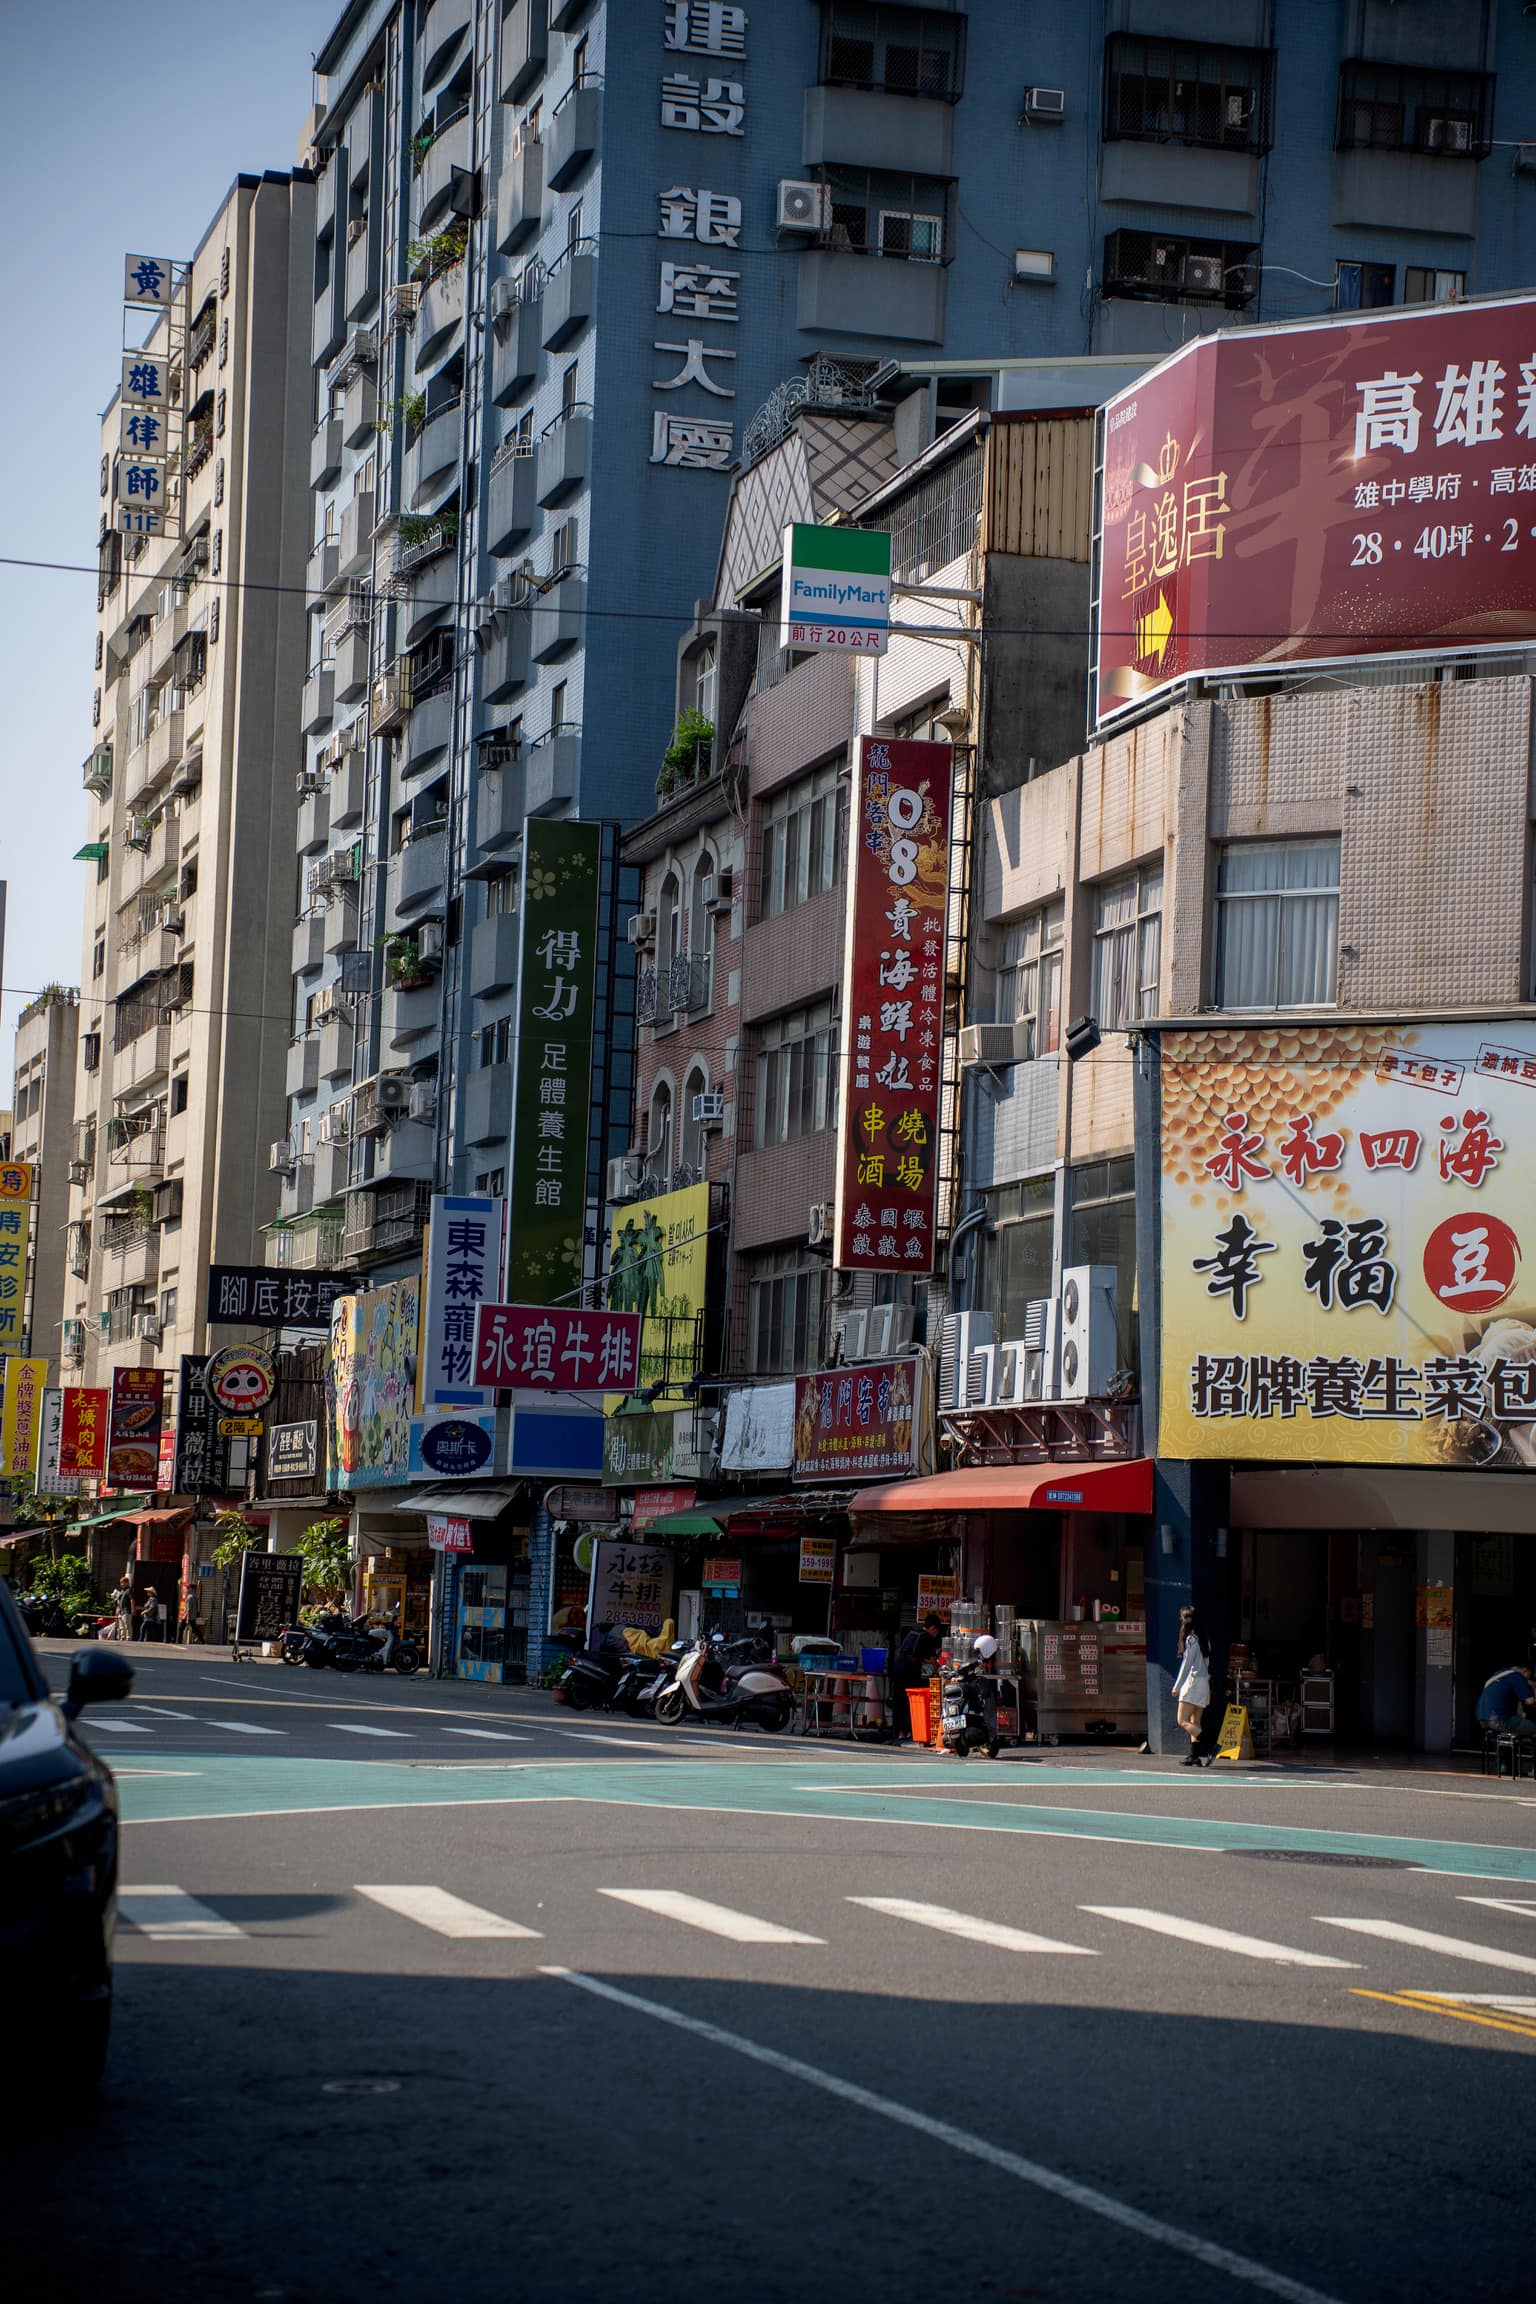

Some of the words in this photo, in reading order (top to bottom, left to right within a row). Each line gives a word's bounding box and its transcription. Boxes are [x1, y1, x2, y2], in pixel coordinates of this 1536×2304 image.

[123, 513, 161, 532] 11F
[1121, 472, 1230, 600] 皇逸居
[794, 580, 886, 605] FamilyMart
[792, 626, 880, 648] 前行20公尺
[532, 928, 582, 1022] 得力
[917, 917, 942, 1091] 批發活體冷凍食品
[1382, 1055, 1457, 1087] 手工包子
[534, 1042, 568, 1207] 足體養生館
[863, 1102, 928, 1145] 串燒
[1205, 1109, 1502, 1190] 永和四海
[856, 1153, 925, 1192] 酒場
[853, 1202, 928, 1229] 泰國蝦
[1193, 1213, 1508, 1320] 幸福豆
[218, 1276, 346, 1319] 腳底按摩
[441, 1219, 488, 1386] 東森寵物
[484, 1315, 633, 1384] 永瑄牛排
[1191, 1353, 1536, 1422] 招牌養生菜包
[609, 1581, 662, 1602] 牛排
